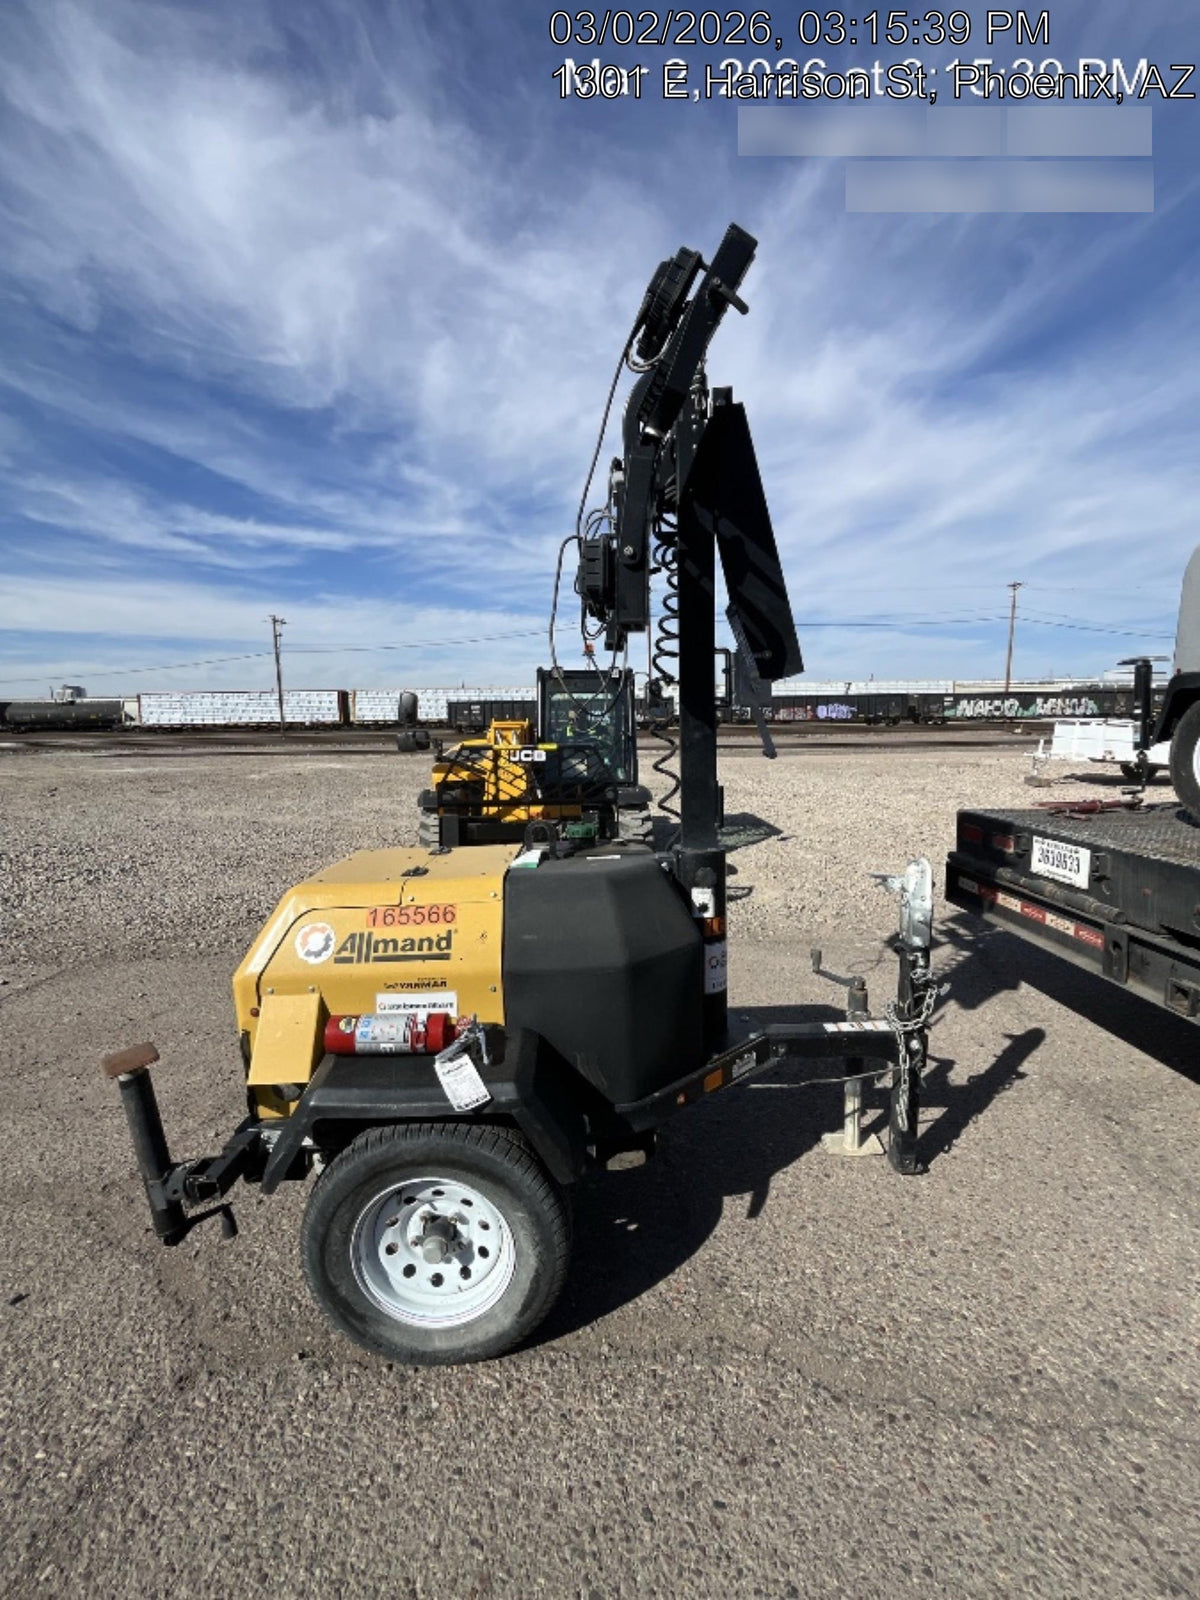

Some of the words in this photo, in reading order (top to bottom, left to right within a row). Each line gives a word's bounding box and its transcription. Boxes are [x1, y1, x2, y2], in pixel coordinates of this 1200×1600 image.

[509, 749, 547, 762] JCB
[369, 904, 456, 927] 165566
[334, 929, 453, 964] Allmand
